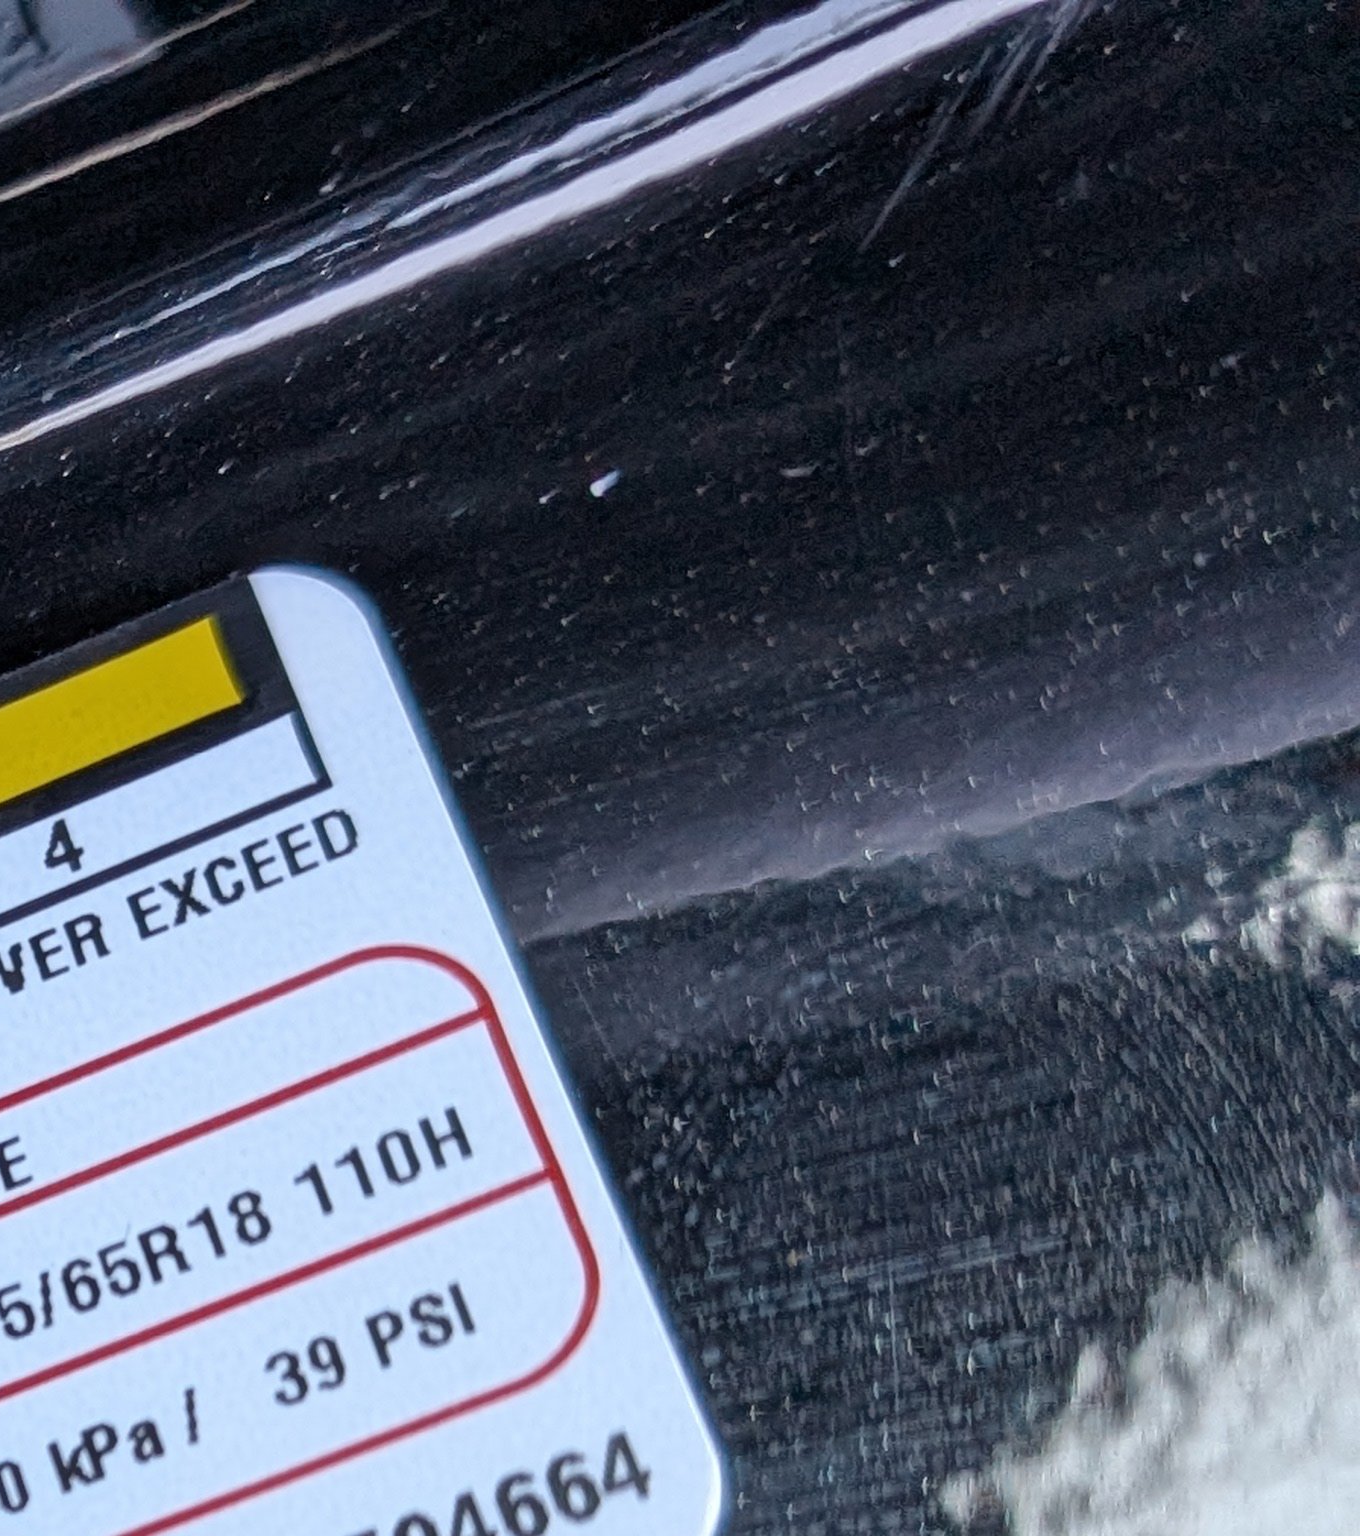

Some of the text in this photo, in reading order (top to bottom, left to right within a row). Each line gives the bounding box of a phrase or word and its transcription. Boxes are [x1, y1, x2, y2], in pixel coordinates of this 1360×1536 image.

[42, 816, 86, 874] 4
[124, 807, 359, 941] EXCEED
[292, 1105, 474, 1216] 110H
[46, 1418, 166, 1495] kPa
[263, 1334, 347, 1407] 39
[363, 1281, 476, 1370] PSI
